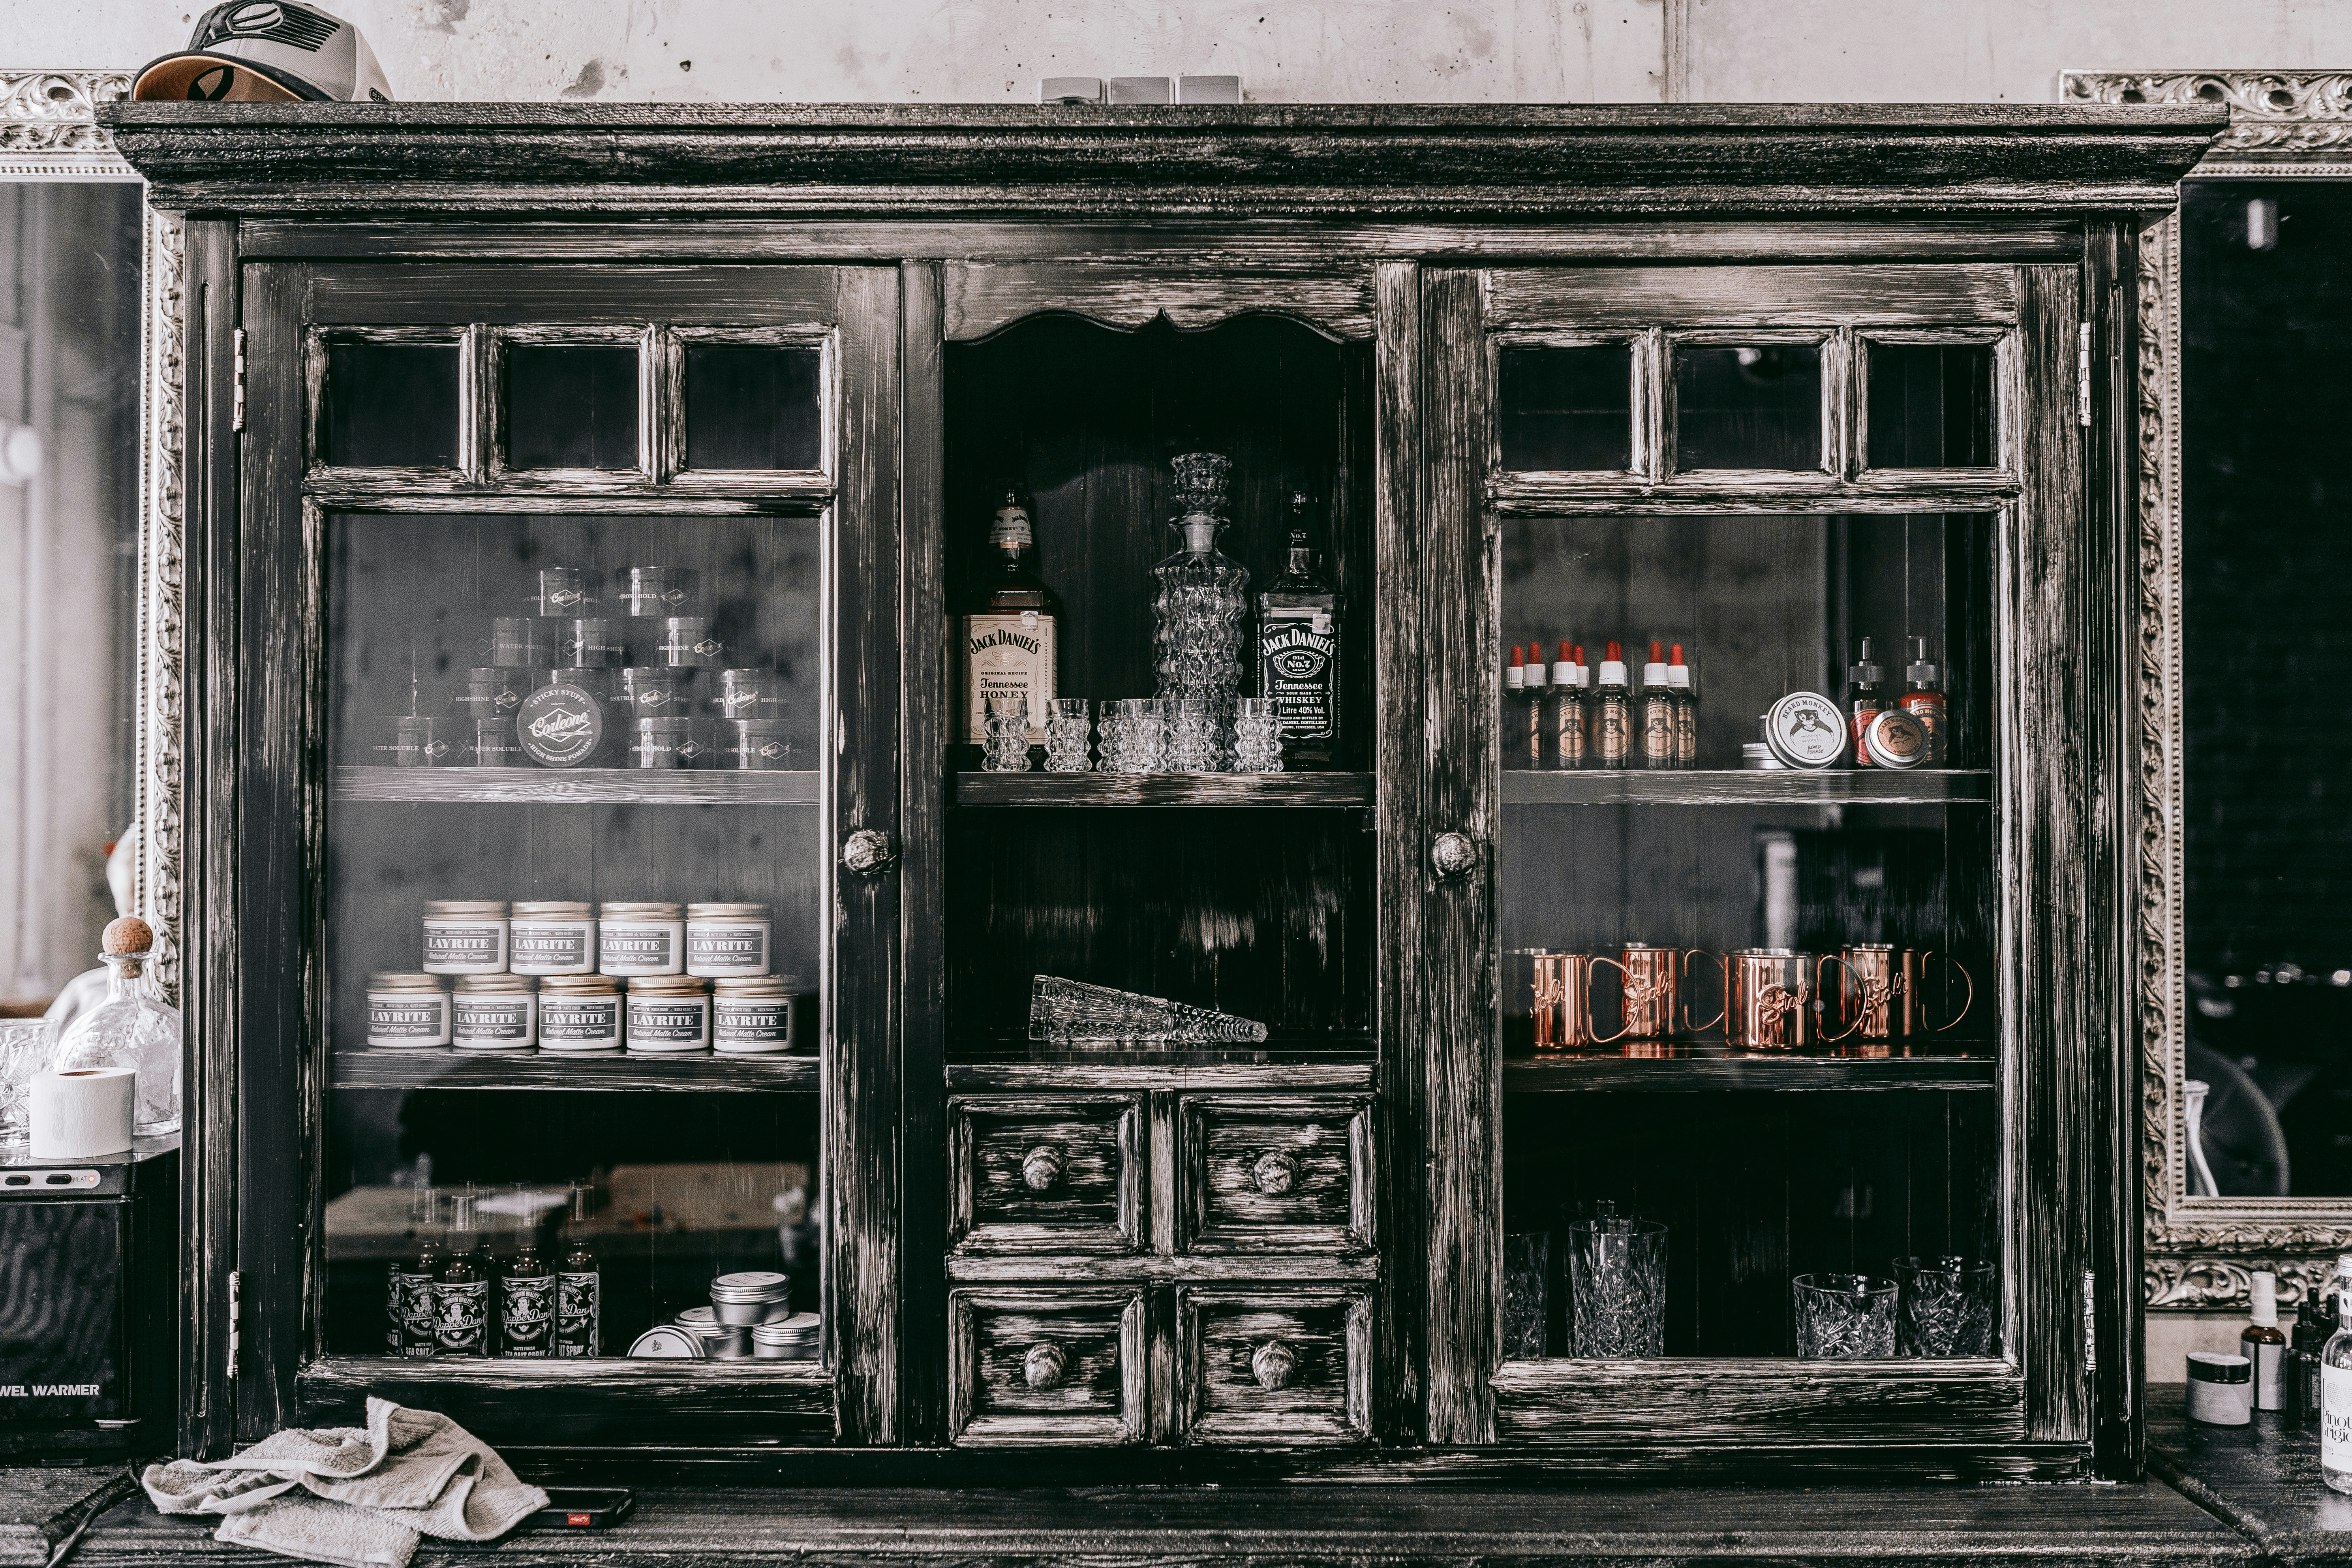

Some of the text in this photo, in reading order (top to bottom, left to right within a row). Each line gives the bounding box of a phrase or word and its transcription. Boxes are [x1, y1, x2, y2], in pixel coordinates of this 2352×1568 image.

[970, 629, 1041, 654] JACK DANIEL'S
[1262, 629, 1336, 656] JACK DANIEL'S
[981, 678, 1028, 688] Tennessee
[1275, 680, 1323, 690] Tennessee
[533, 689, 559, 705] STICKY
[561, 689, 585, 702] STUFF
[728, 693, 756, 705] Corleone
[1782, 700, 1832, 719] BEARD MONKEY
[532, 712, 588, 737] Corleone
[1879, 721, 1890, 734] BEARD
[529, 744, 544, 758] HIGH
[568, 740, 592, 760] POMADE
[428, 938, 489, 948] LAYRITE
[515, 939, 575, 950] LAYRITE
[603, 940, 660, 951] LAYRITE
[693, 941, 753, 951] LAYRITE
[371, 1011, 430, 1022] LAYRITE
[457, 1012, 516, 1023] LAYRITE
[545, 1013, 606, 1024] LAYRITE
[633, 1014, 693, 1025] LAYRITE
[718, 1015, 777, 1026] LAYRITE
[633, 1028, 653, 1037] Natural
[511, 1291, 525, 1299] PREMIUM
[443, 1296, 473, 1306] PREMIUM QUALITY
[567, 1303, 589, 1315] Dan
[403, 1307, 432, 1324] Dapper
[503, 1309, 550, 1328] Dapper Dan
[434, 1314, 483, 1334] Dapper Dan
[526, 1327, 542, 1340] PRODUCTS
[459, 1333, 475, 1346] PRODUCTS
[406, 1347, 414, 1355] SEA
[566, 1345, 584, 1356] SPRAY
[32, 1385, 99, 1396] WARMER
[2322, 1407, 2352, 1429] Pinot
